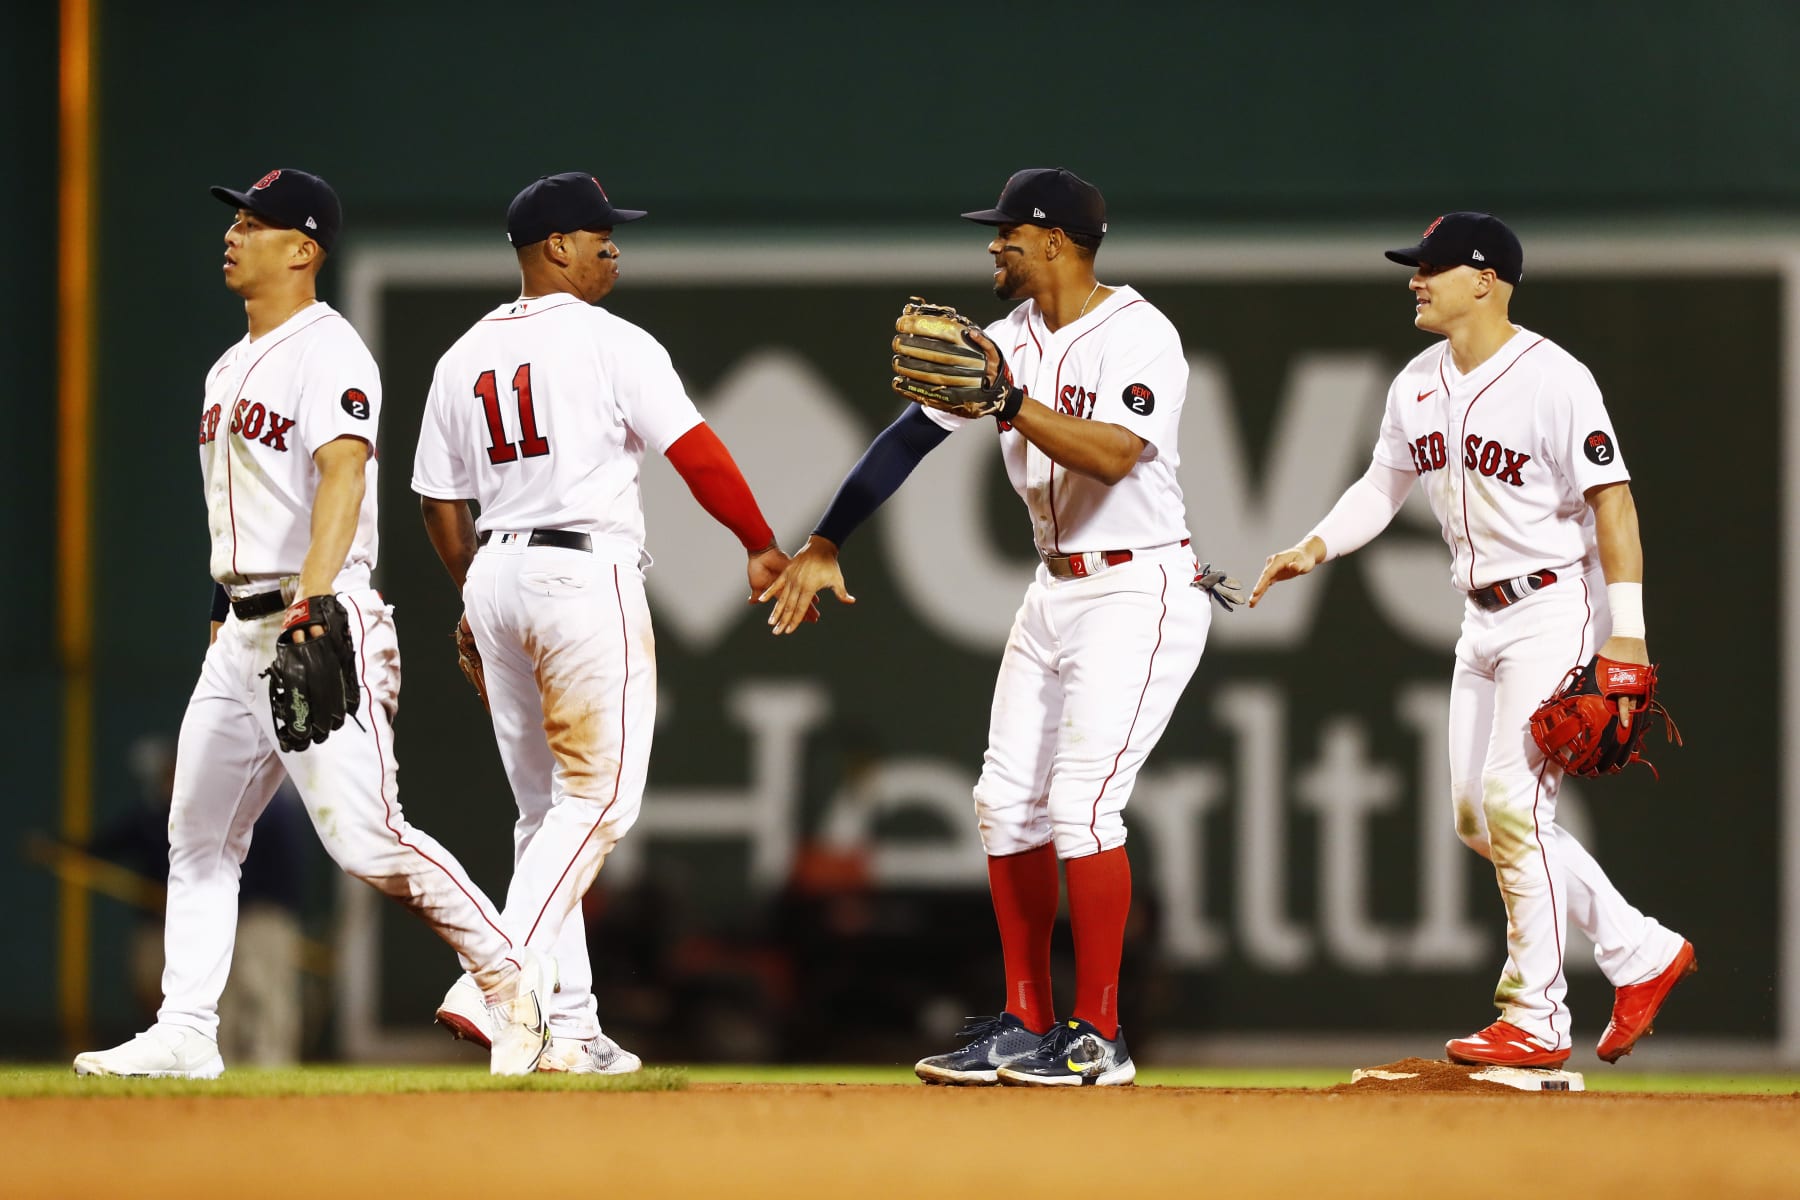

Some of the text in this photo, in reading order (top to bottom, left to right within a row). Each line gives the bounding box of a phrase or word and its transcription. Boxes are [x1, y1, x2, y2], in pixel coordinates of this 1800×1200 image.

[1131, 385, 1151, 400] REMY
[352, 401, 365, 417] 2
[1132, 396, 1146, 412] 2
[474, 362, 549, 465] 11
[199, 398, 296, 452] ED SOX
[1465, 433, 1531, 487] SOX
[1595, 445, 1610, 461] 2
